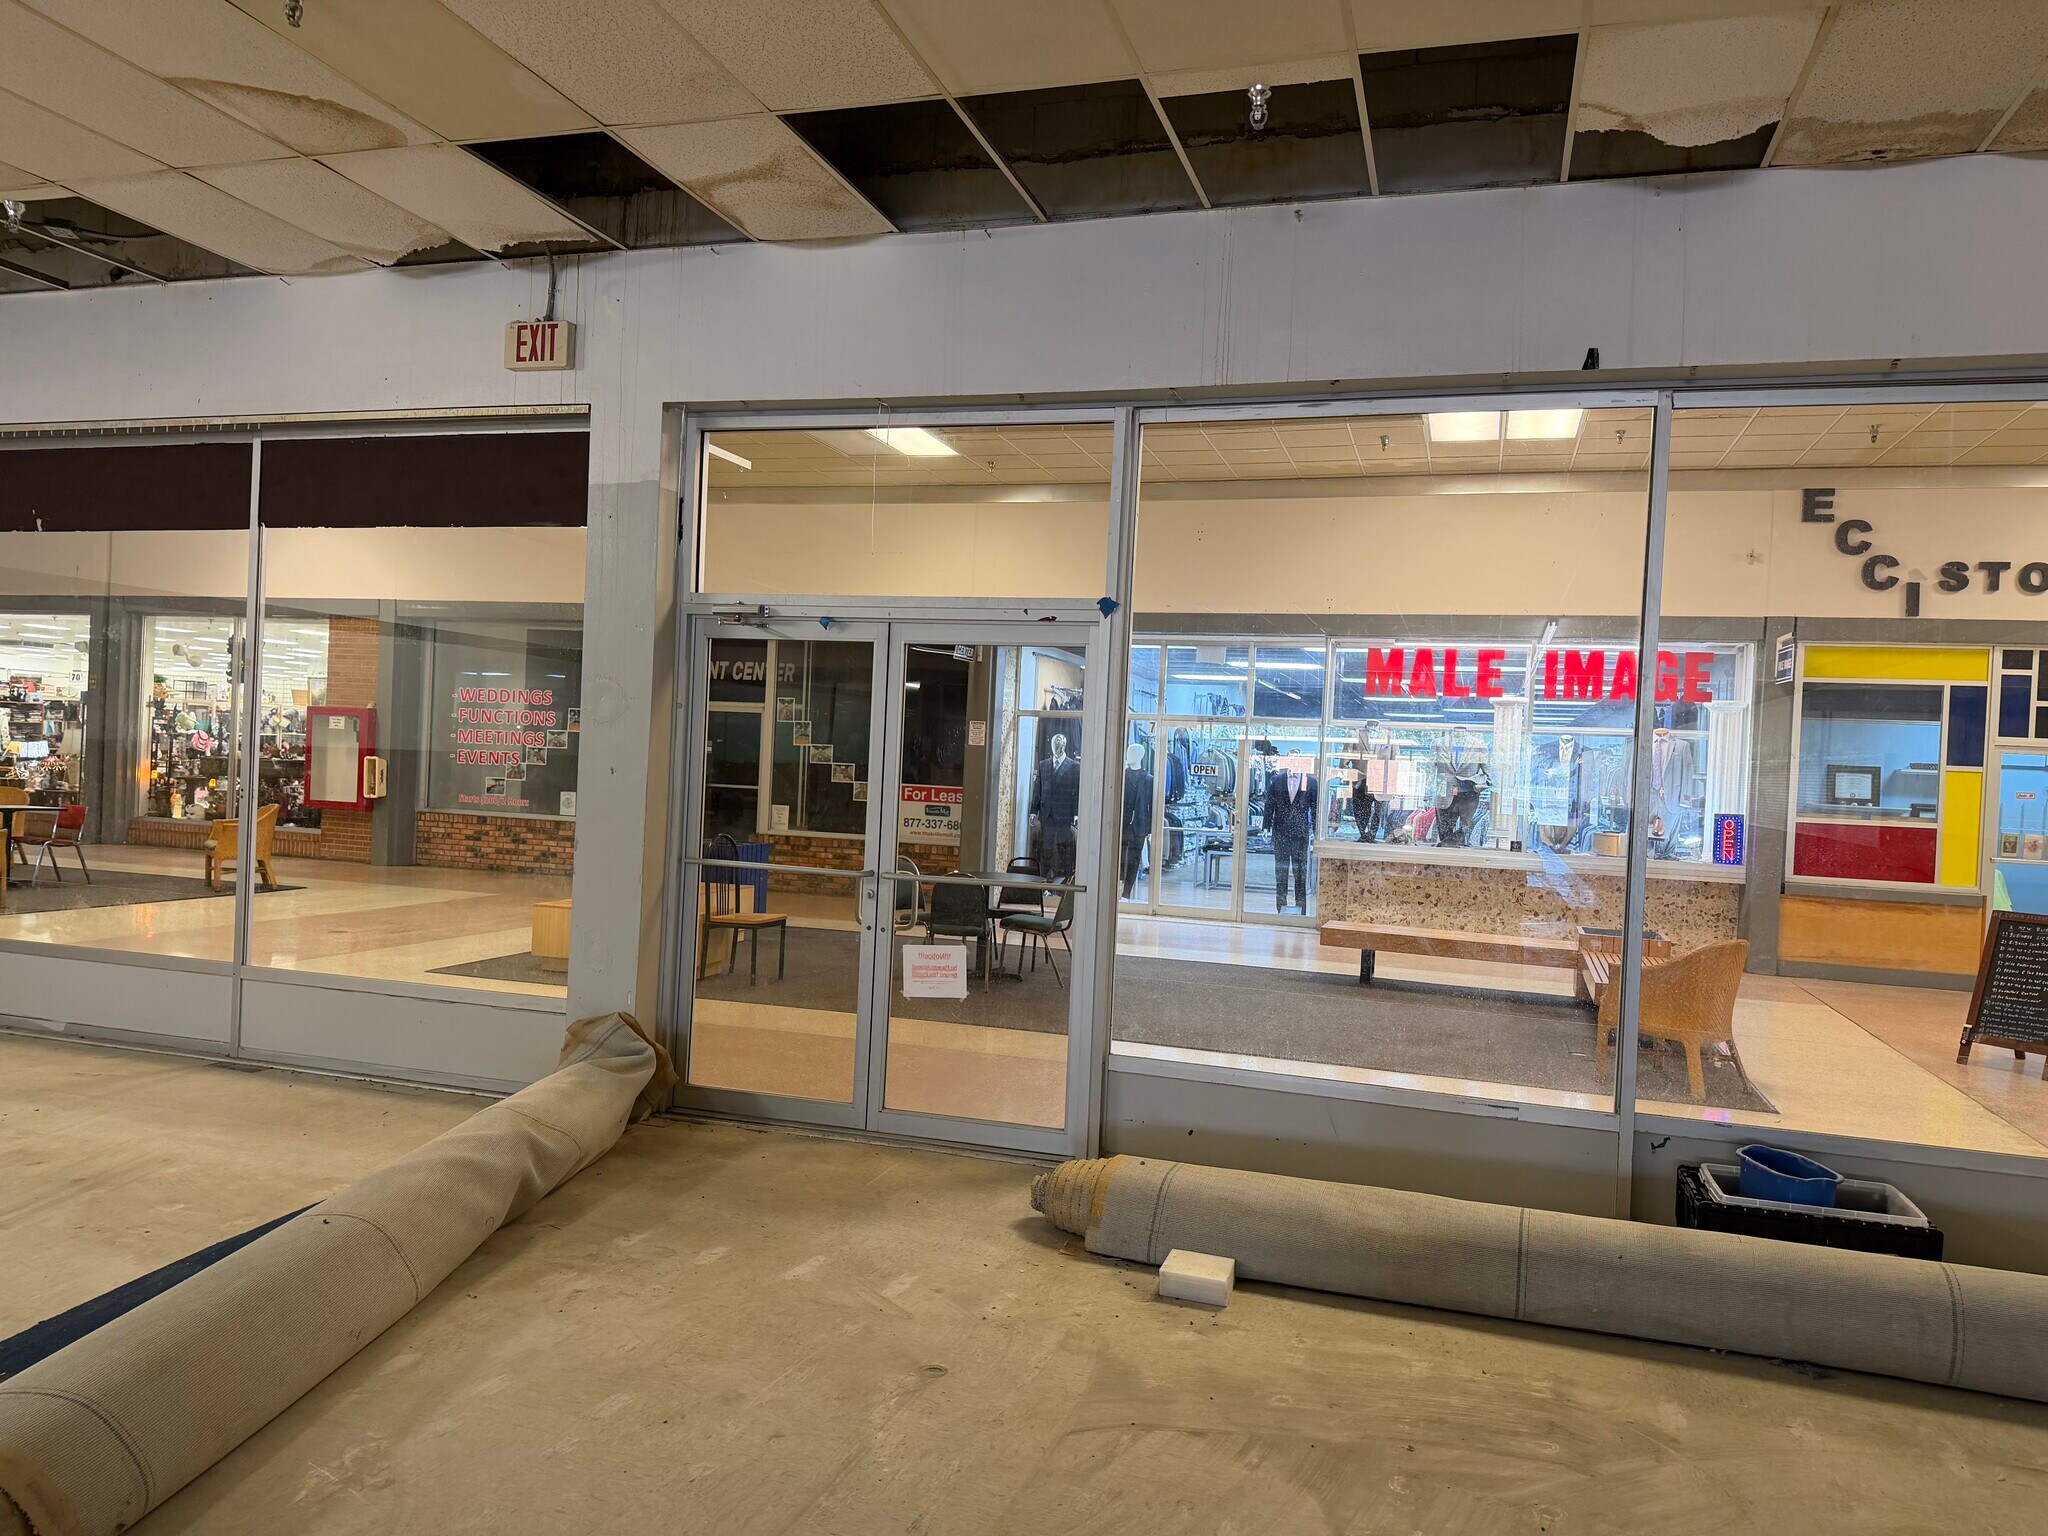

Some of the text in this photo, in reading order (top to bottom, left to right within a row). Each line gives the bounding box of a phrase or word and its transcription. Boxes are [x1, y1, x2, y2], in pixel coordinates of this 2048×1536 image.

[516, 323, 558, 362] EXIT
[732, 662, 796, 682] CENER
[1365, 648, 1714, 703] MALE IMAGE
[1193, 765, 1216, 775] OPEN
[904, 787, 963, 803] For Leas
[903, 817, 961, 831] 877-337-68
[1723, 819, 1735, 861] OPEN
